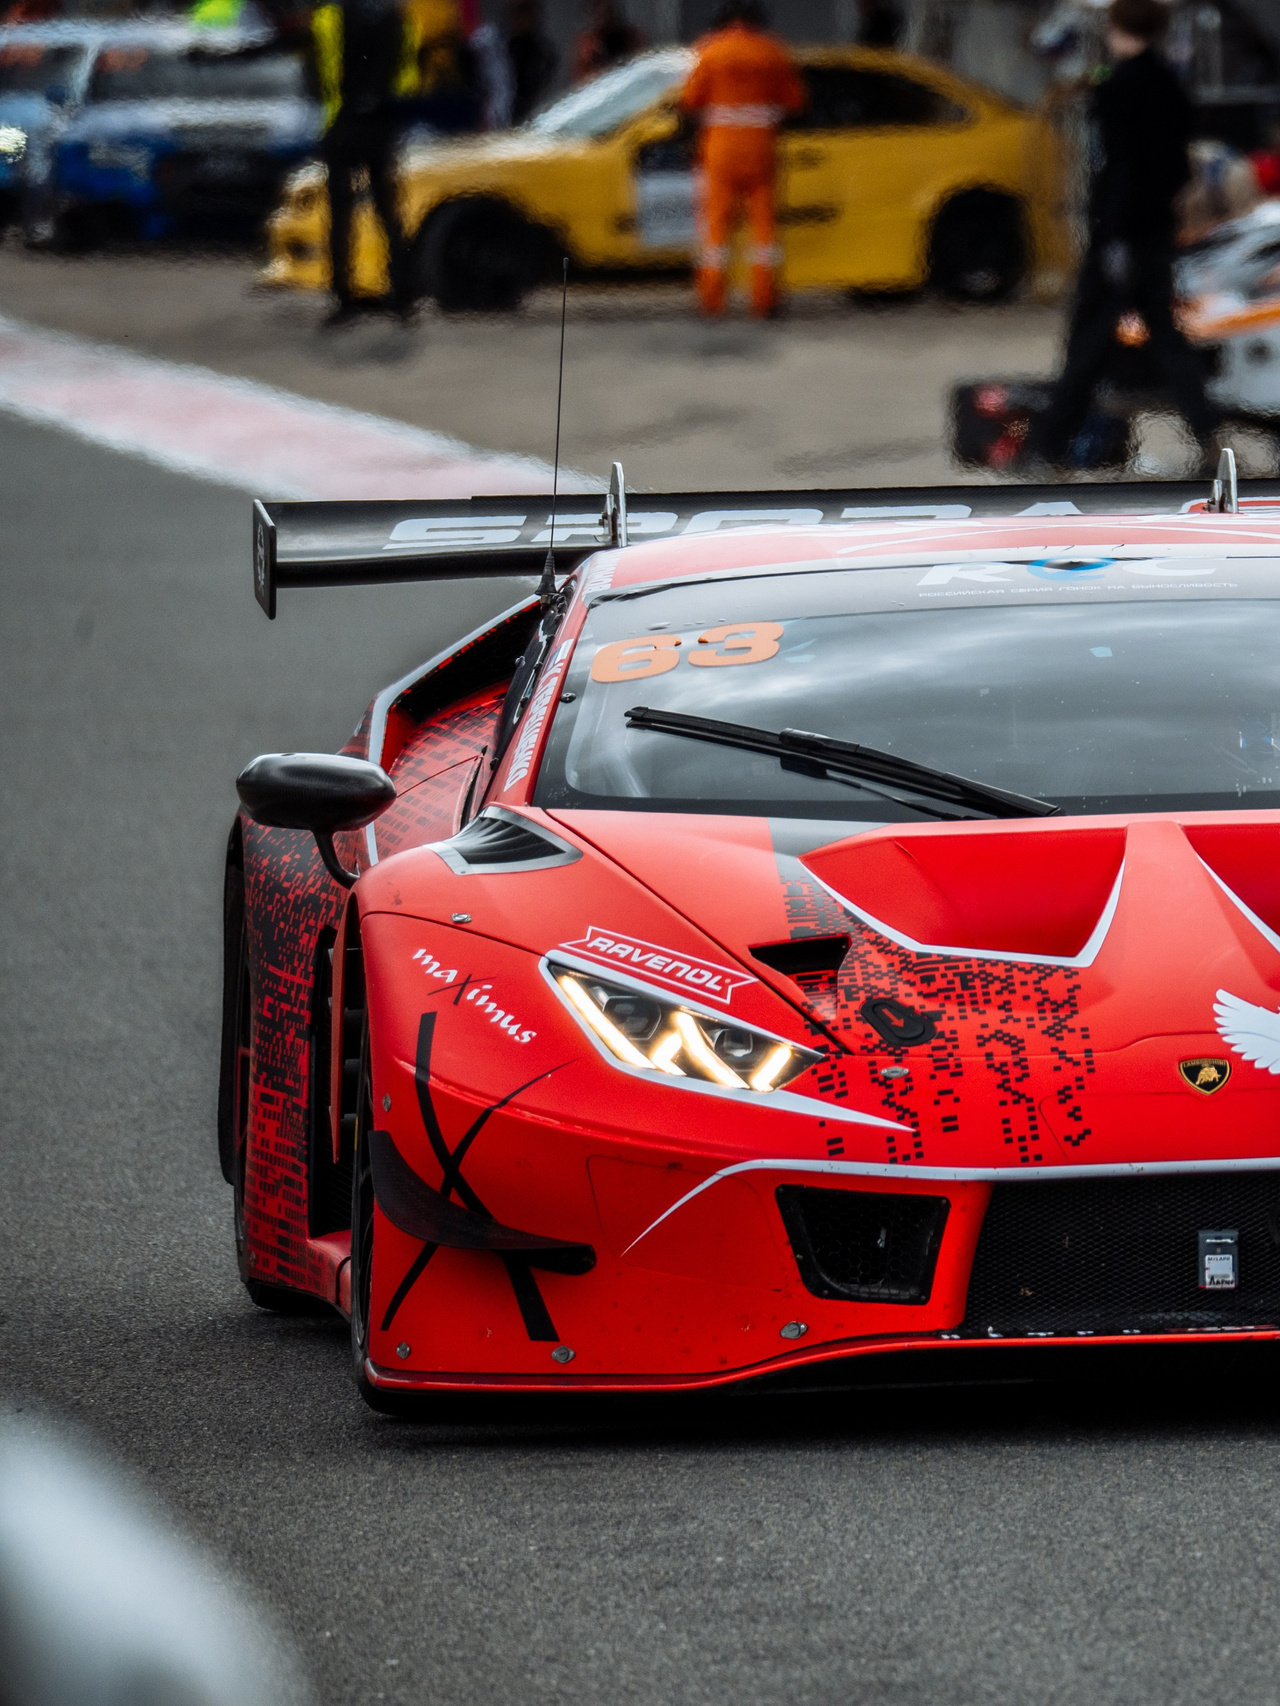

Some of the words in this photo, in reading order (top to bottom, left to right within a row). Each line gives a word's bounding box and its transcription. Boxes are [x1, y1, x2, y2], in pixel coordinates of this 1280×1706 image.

[1010, 586, 1053, 594] СЕРИЯ
[591, 622, 784, 683] 63
[586, 936, 724, 991] RAVENOL
